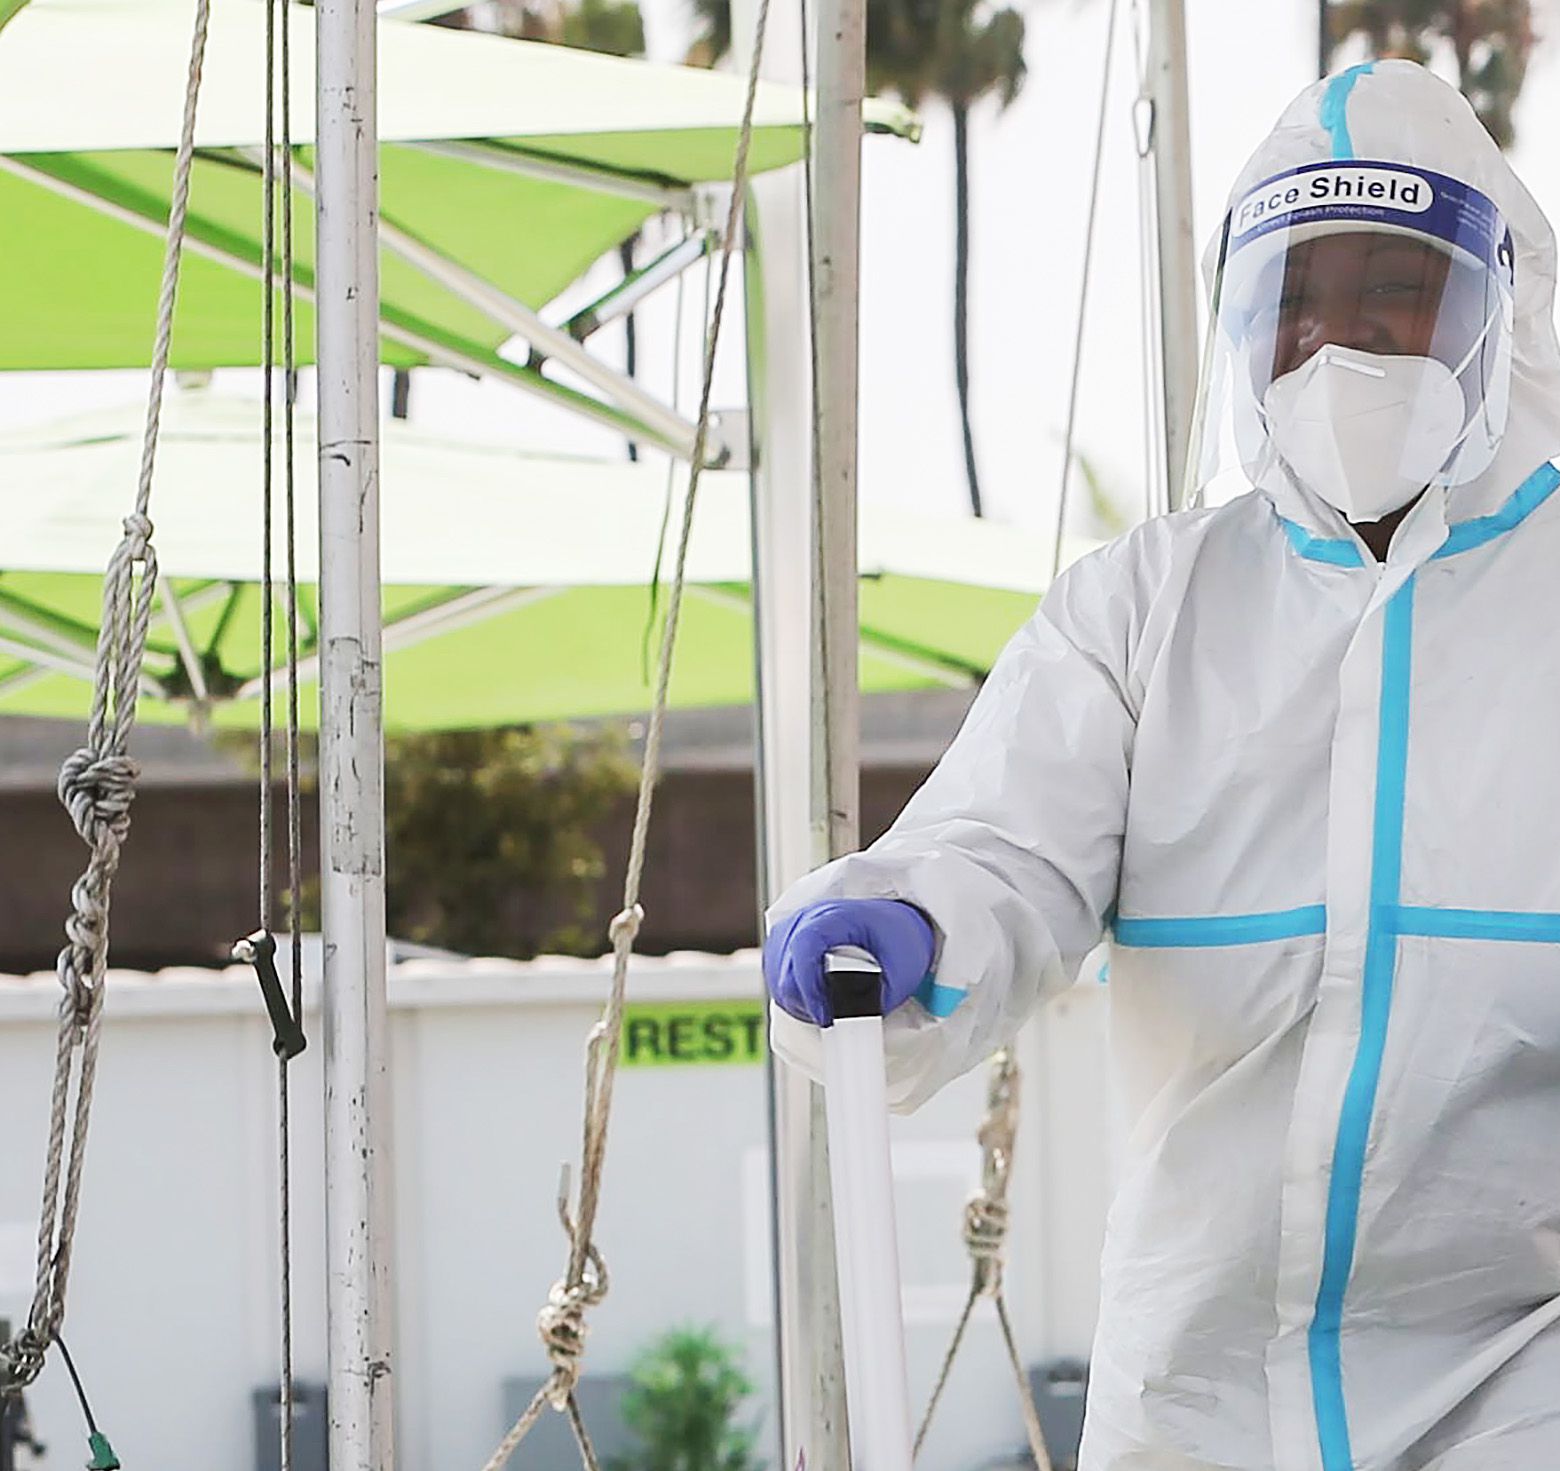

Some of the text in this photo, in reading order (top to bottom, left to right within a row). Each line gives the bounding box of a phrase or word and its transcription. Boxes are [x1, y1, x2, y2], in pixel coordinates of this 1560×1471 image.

[1238, 175, 1420, 228] Face Shield
[626, 1012, 764, 1064] REST
